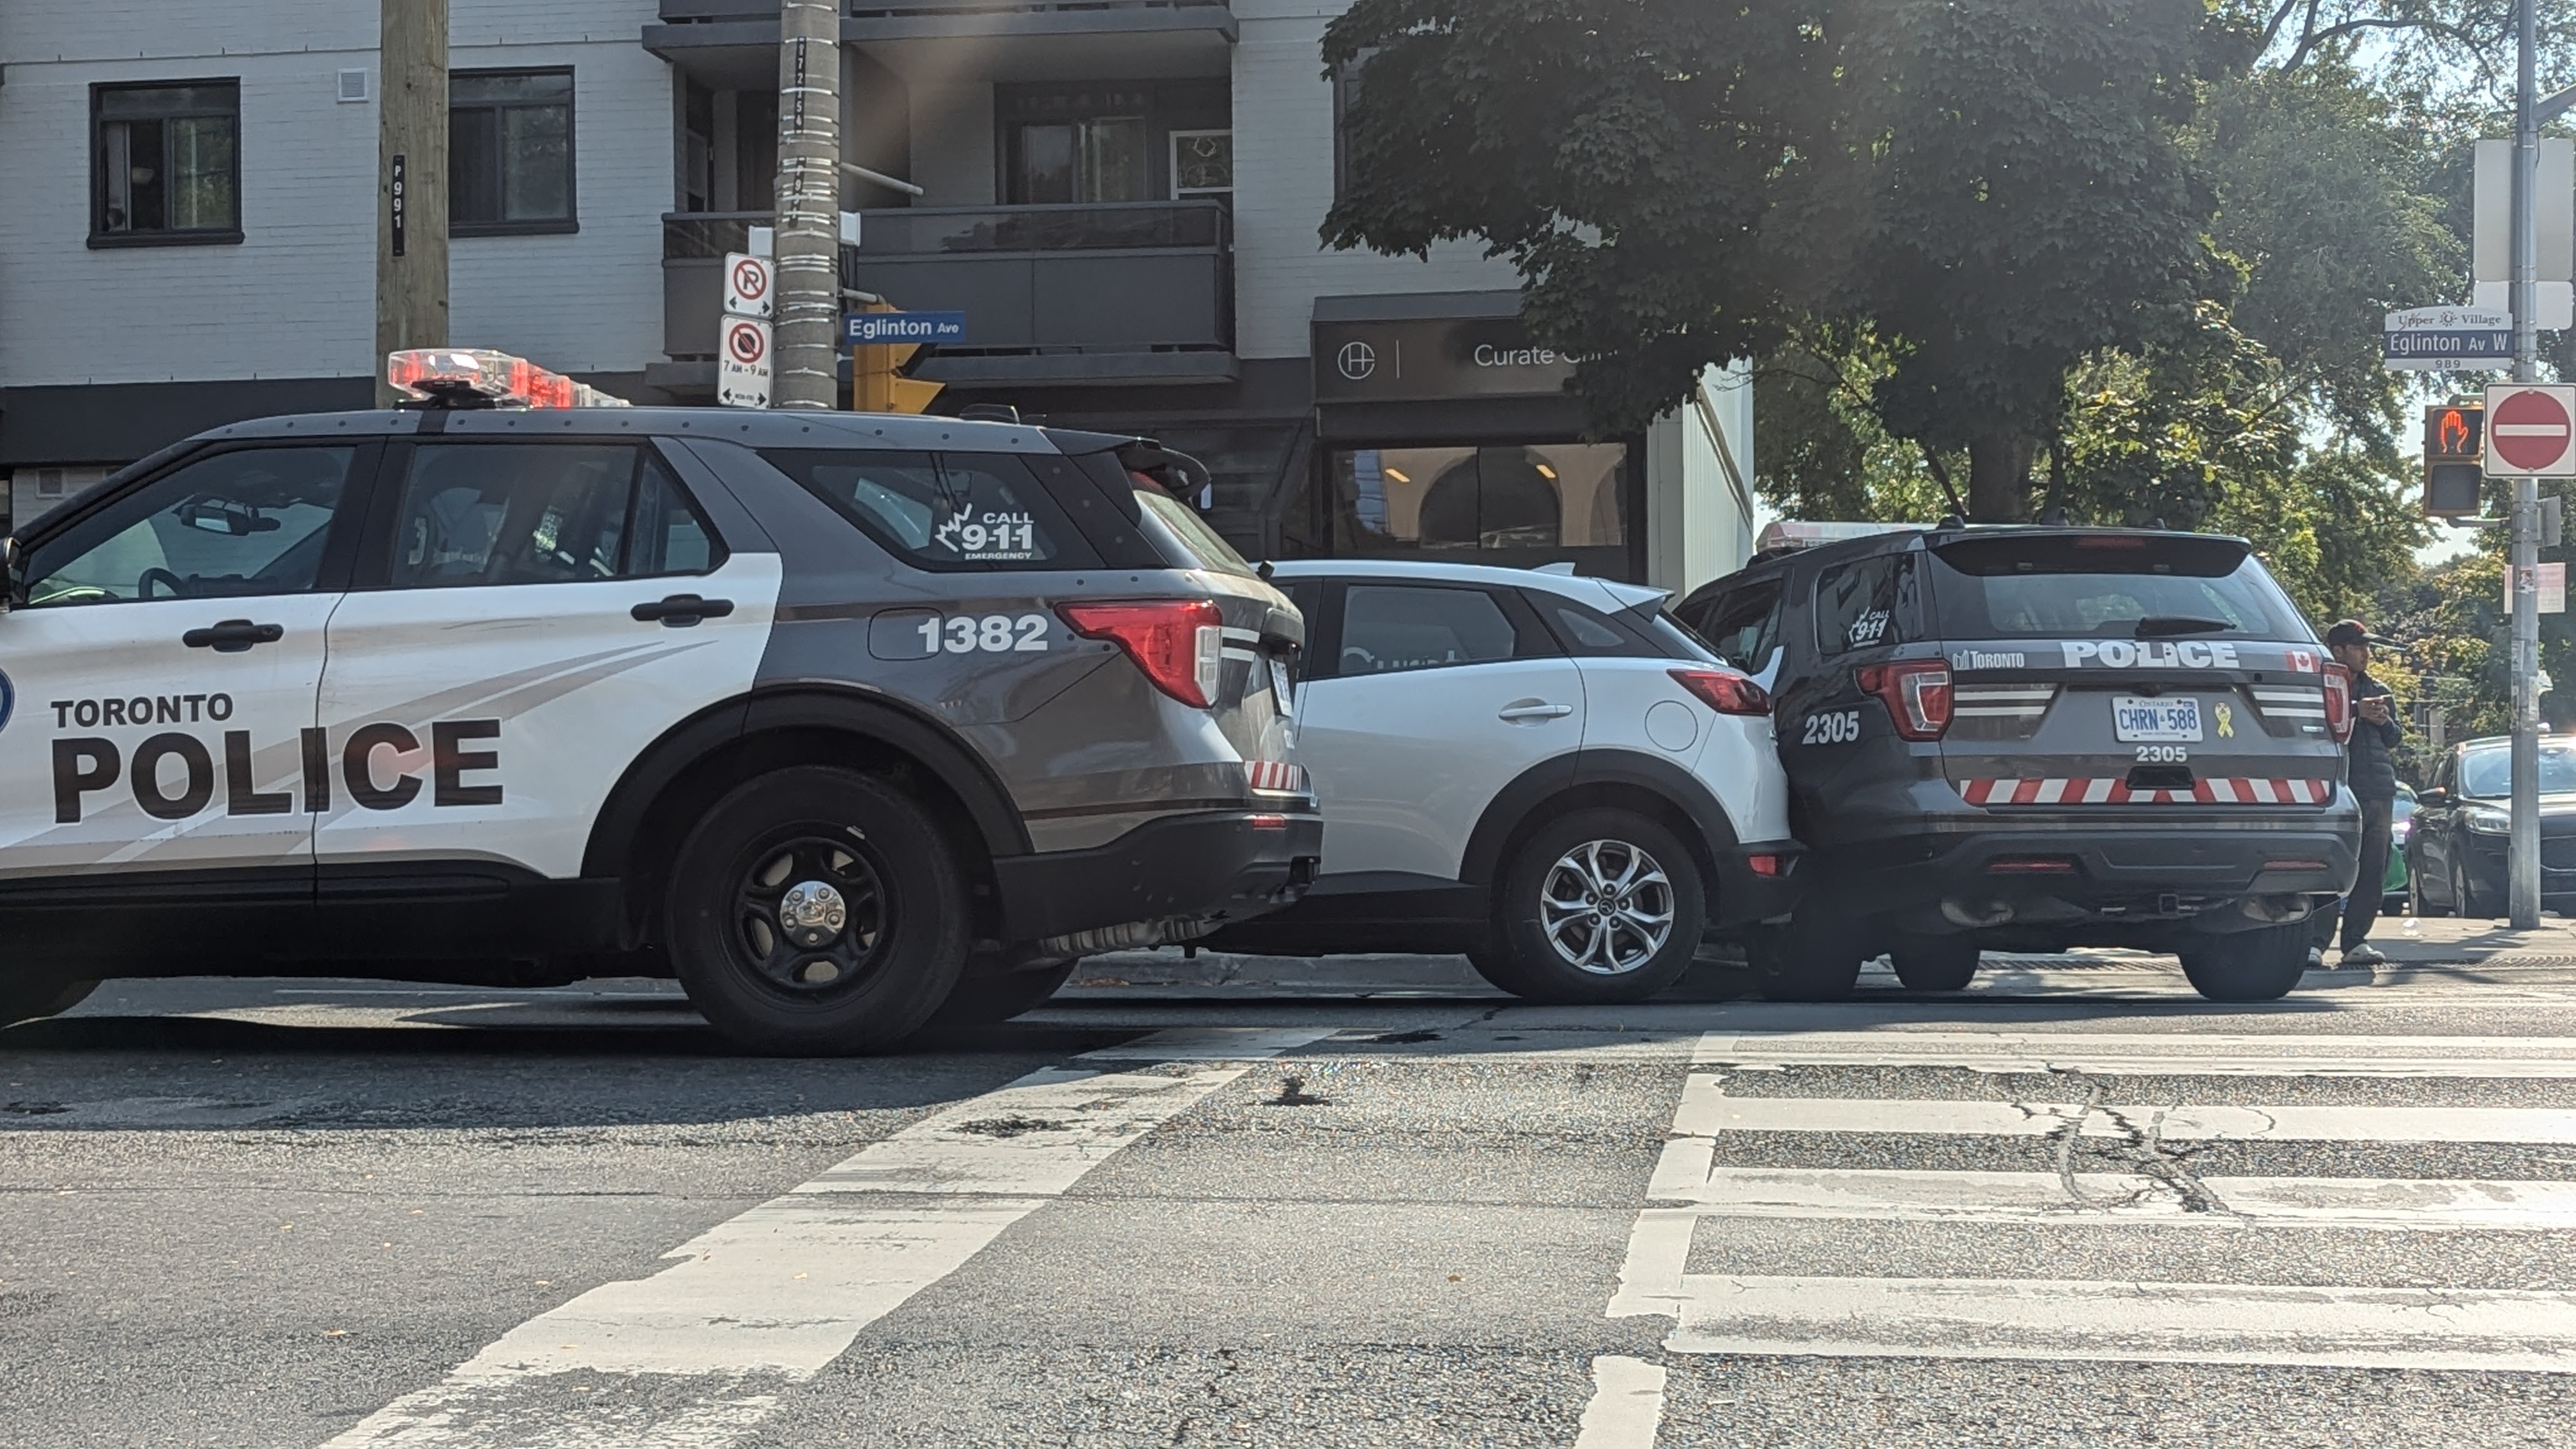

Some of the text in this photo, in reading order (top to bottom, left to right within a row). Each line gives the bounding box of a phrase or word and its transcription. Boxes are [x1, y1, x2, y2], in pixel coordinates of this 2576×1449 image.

[394, 165, 402, 228] P991
[850, 318, 959, 339] Eglinton Ave
[2398, 314, 2501, 328] Upper Village
[1474, 344, 1554, 366] Curate
[2391, 333, 2508, 355] Eglinton Av W
[724, 360, 730, 371] 7
[750, 364, 756, 375] 9
[2435, 360, 2461, 368] 989
[983, 512, 1034, 524] CALL
[962, 524, 1032, 550] 9-1-1
[1869, 610, 1890, 620] CALL
[917, 614, 1048, 653] 1382
[1855, 618, 1887, 641] 9-1-1
[1969, 650, 2025, 668] TORONTO
[2061, 641, 2240, 668] POLICE
[50, 693, 234, 728] TORONTO
[2119, 709, 2197, 730] CHRN 588
[1802, 710, 1859, 744] 2305
[2136, 746, 2188, 762] 2305
[52, 717, 504, 824] POLICE
